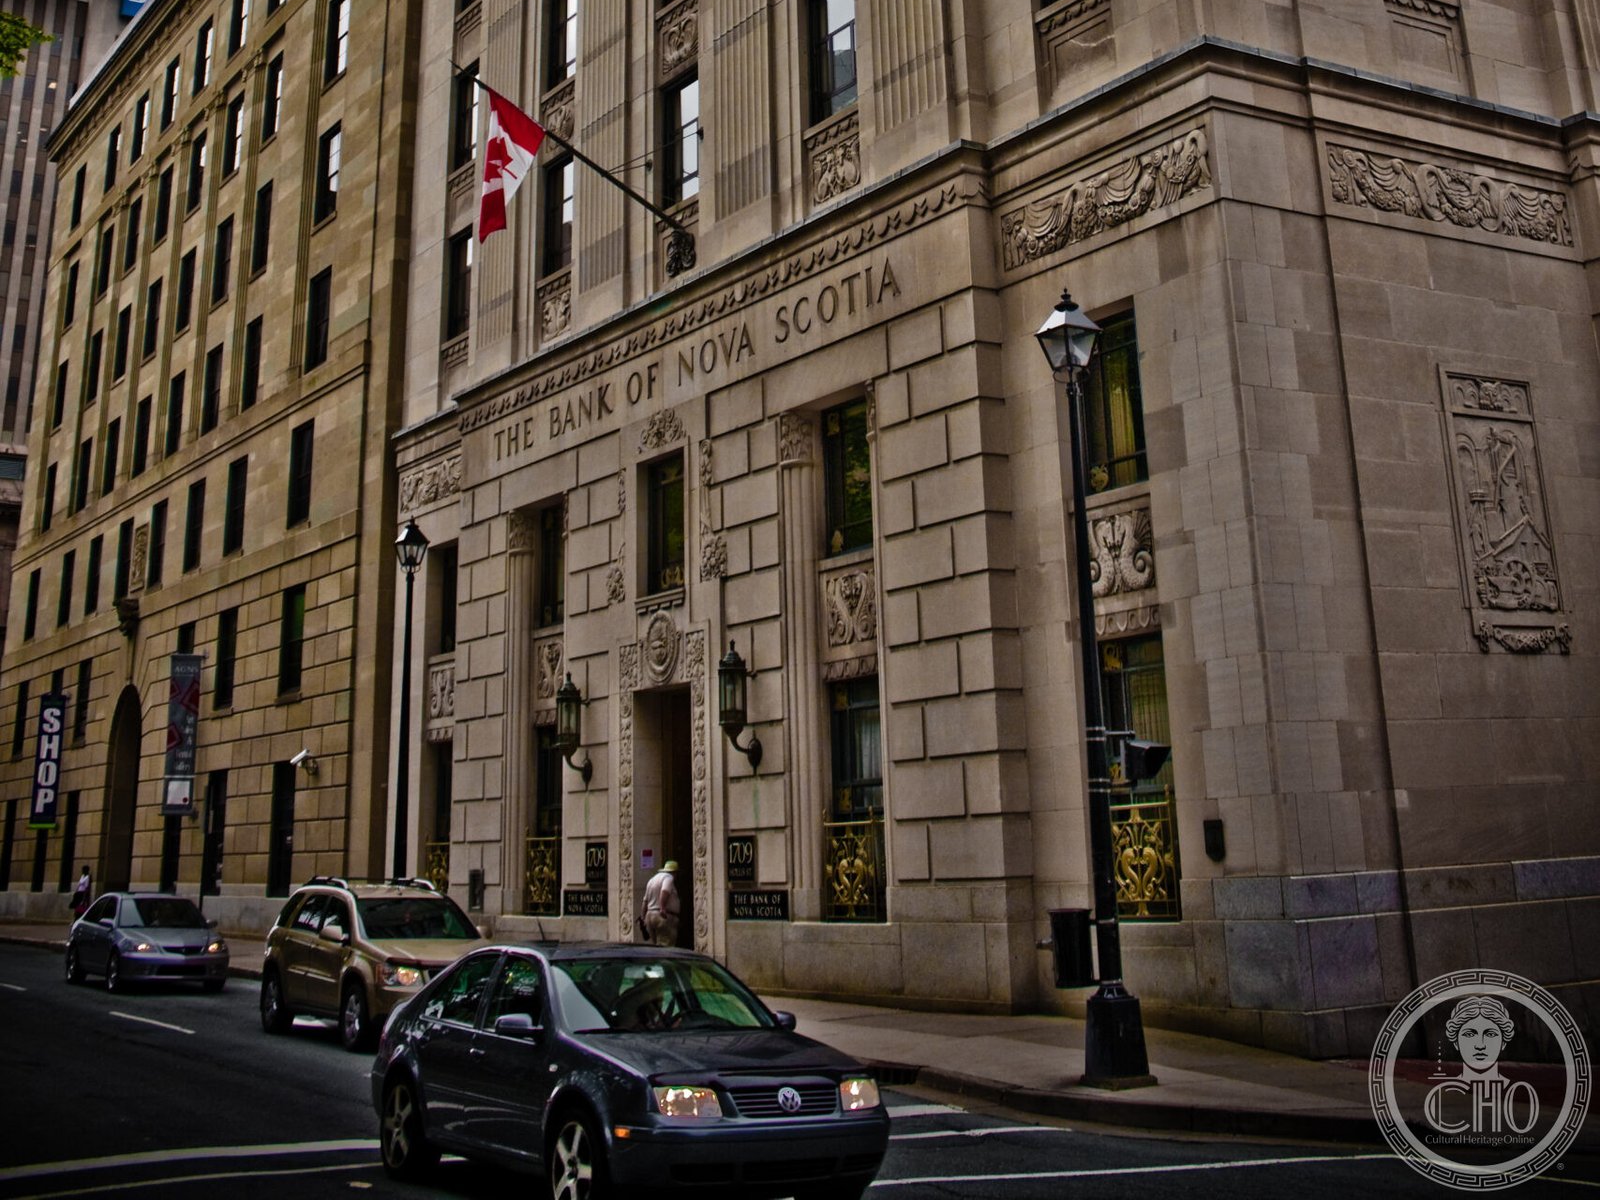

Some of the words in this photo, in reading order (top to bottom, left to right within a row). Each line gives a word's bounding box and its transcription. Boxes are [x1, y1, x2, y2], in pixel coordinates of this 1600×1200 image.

[494, 417, 534, 461] THE
[549, 382, 613, 440] BANK
[626, 362, 659, 405] OF
[677, 321, 755, 387] NOVA
[775, 257, 901, 343] SCOTIA
[35, 708, 61, 813] SHOP
[587, 848, 605, 867] 1709
[729, 841, 753, 864] 1709
[734, 894, 748, 905] THE
[750, 894, 768, 904] BANK
[772, 894, 781, 904] OF
[734, 906, 752, 917] NOVA
[757, 906, 782, 917] SCOTIA
